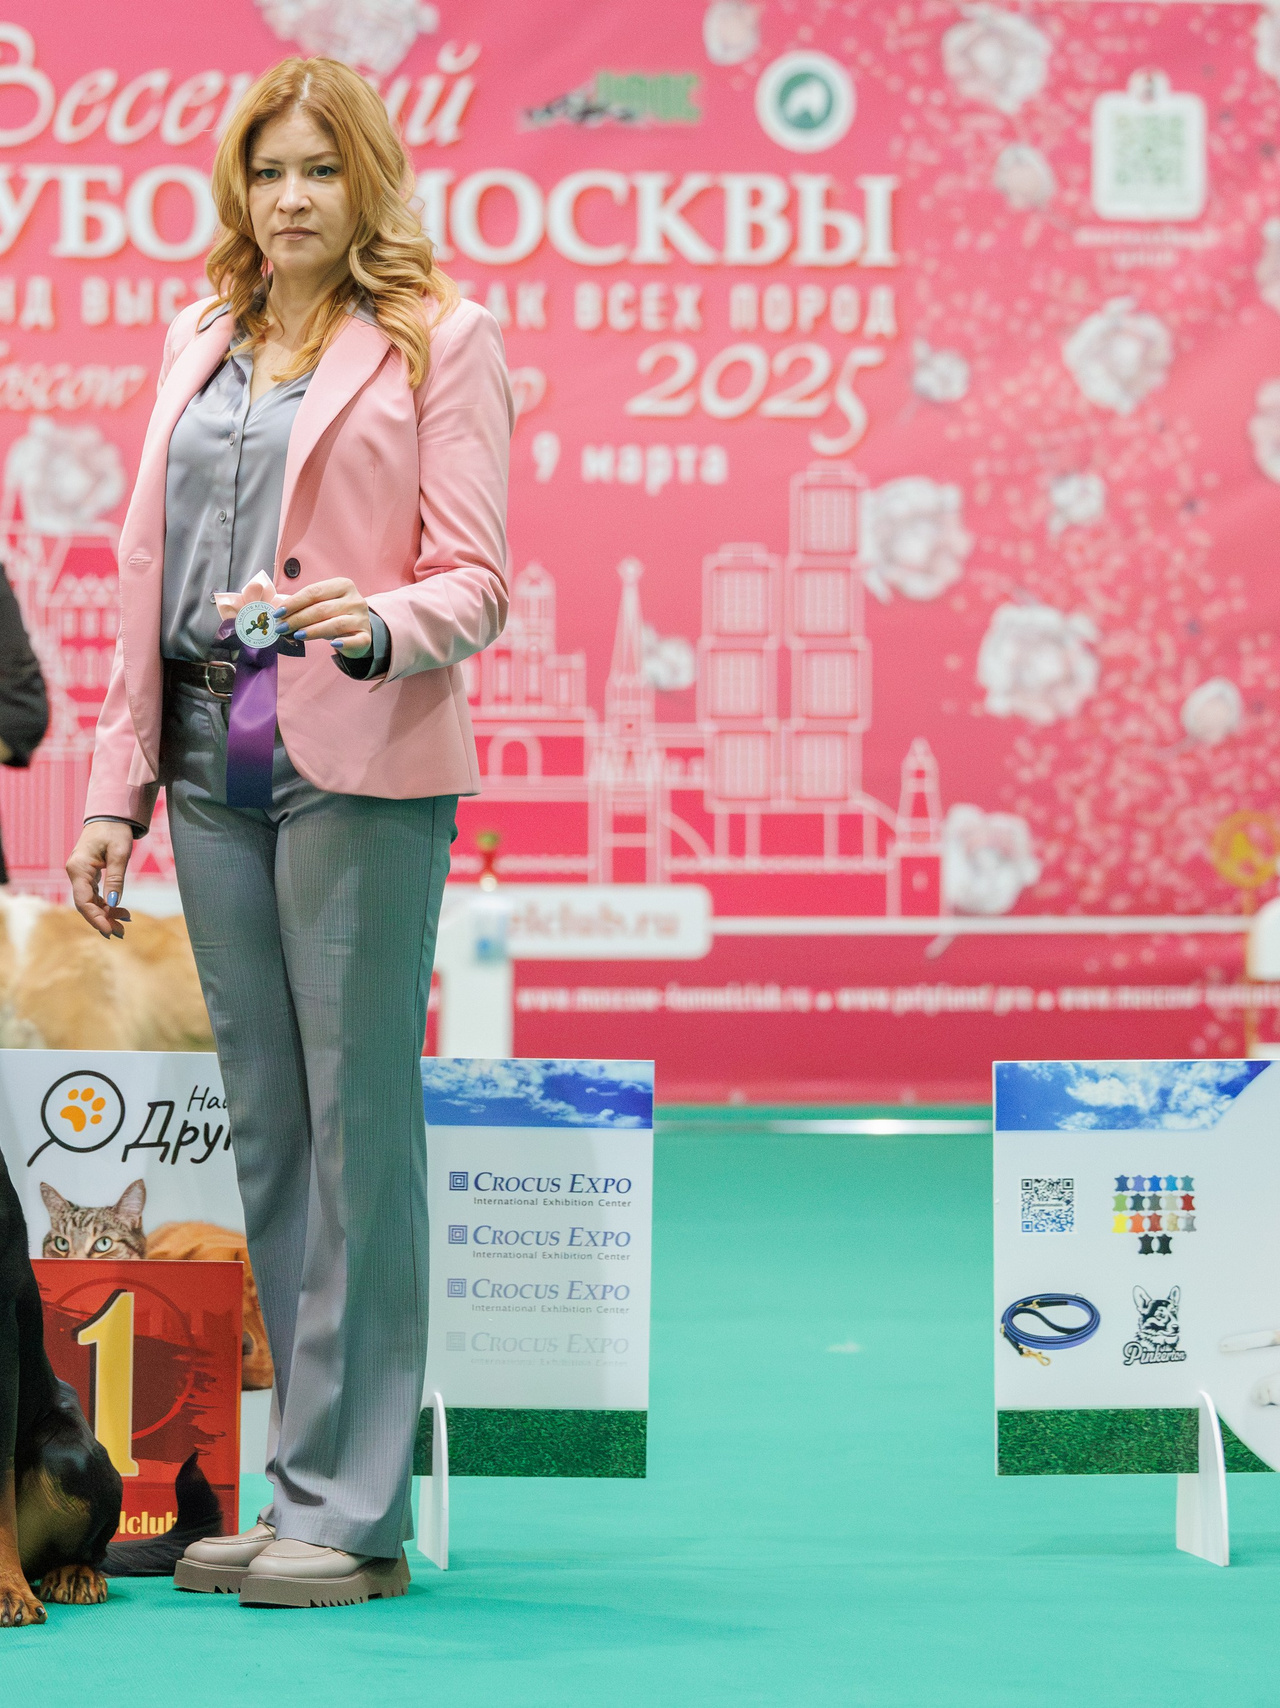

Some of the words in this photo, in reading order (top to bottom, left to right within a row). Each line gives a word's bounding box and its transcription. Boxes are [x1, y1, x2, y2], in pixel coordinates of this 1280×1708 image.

[574, 281, 702, 332] ВСЕХ
[728, 283, 898, 339] ПОРОД
[626, 340, 886, 457] 2025
[581, 443, 729, 497] марта
[187, 1085, 227, 1112] На
[474, 1172, 560, 1193] CROCUS
[569, 1173, 632, 1194] EXPO
[474, 1197, 538, 1206] International
[543, 1198, 594, 1207] Exhibition
[598, 1199, 632, 1208] Center
[472, 1225, 560, 1246] CROCUS
[567, 1227, 631, 1248] EXPO
[472, 1250, 538, 1260] International
[542, 1252, 593, 1260] Exhibition
[597, 1252, 631, 1261] Center
[472, 1278, 559, 1300] CROCUS
[566, 1280, 630, 1301] EXPO
[470, 1332, 558, 1353] CROCUS
[566, 1334, 629, 1354] EXPO
[1123, 1341, 1187, 1366] Pinkerton
[73, 1289, 139, 1476] 1
